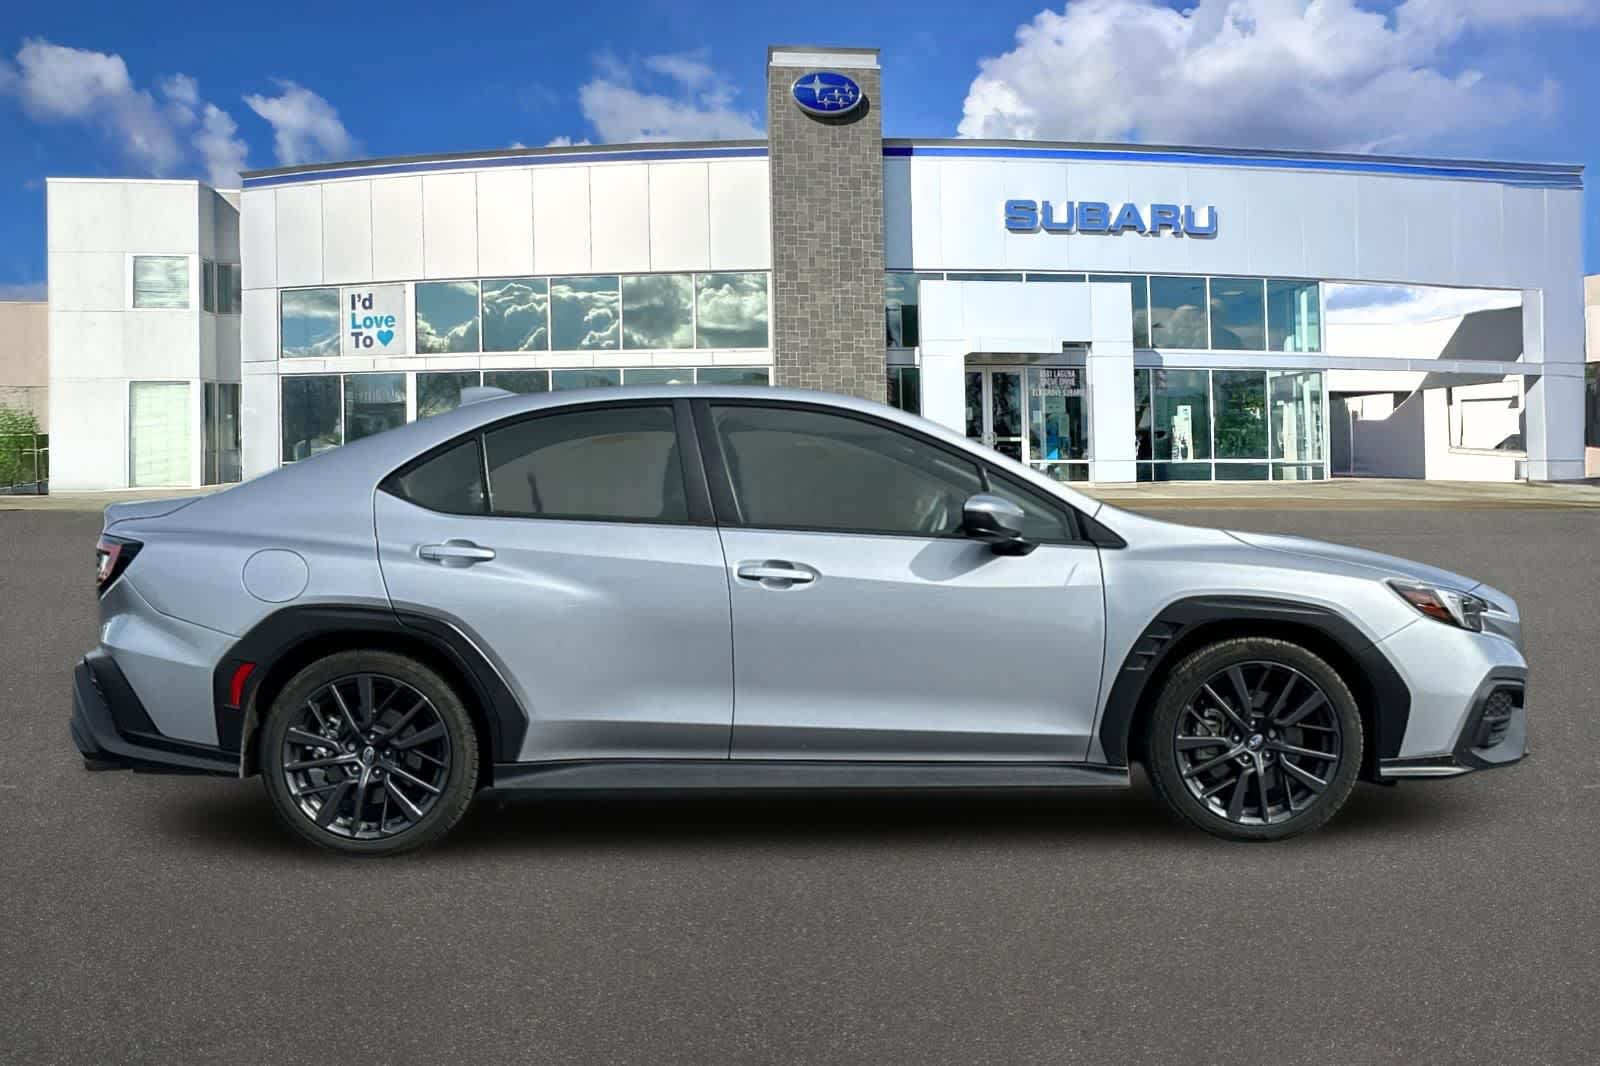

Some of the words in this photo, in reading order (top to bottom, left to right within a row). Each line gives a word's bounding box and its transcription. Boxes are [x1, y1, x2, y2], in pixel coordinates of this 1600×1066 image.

[1005, 199, 1217, 239] SUBARU
[351, 293, 373, 310] I'd
[351, 313, 396, 329] Love
[351, 331, 373, 348] To
